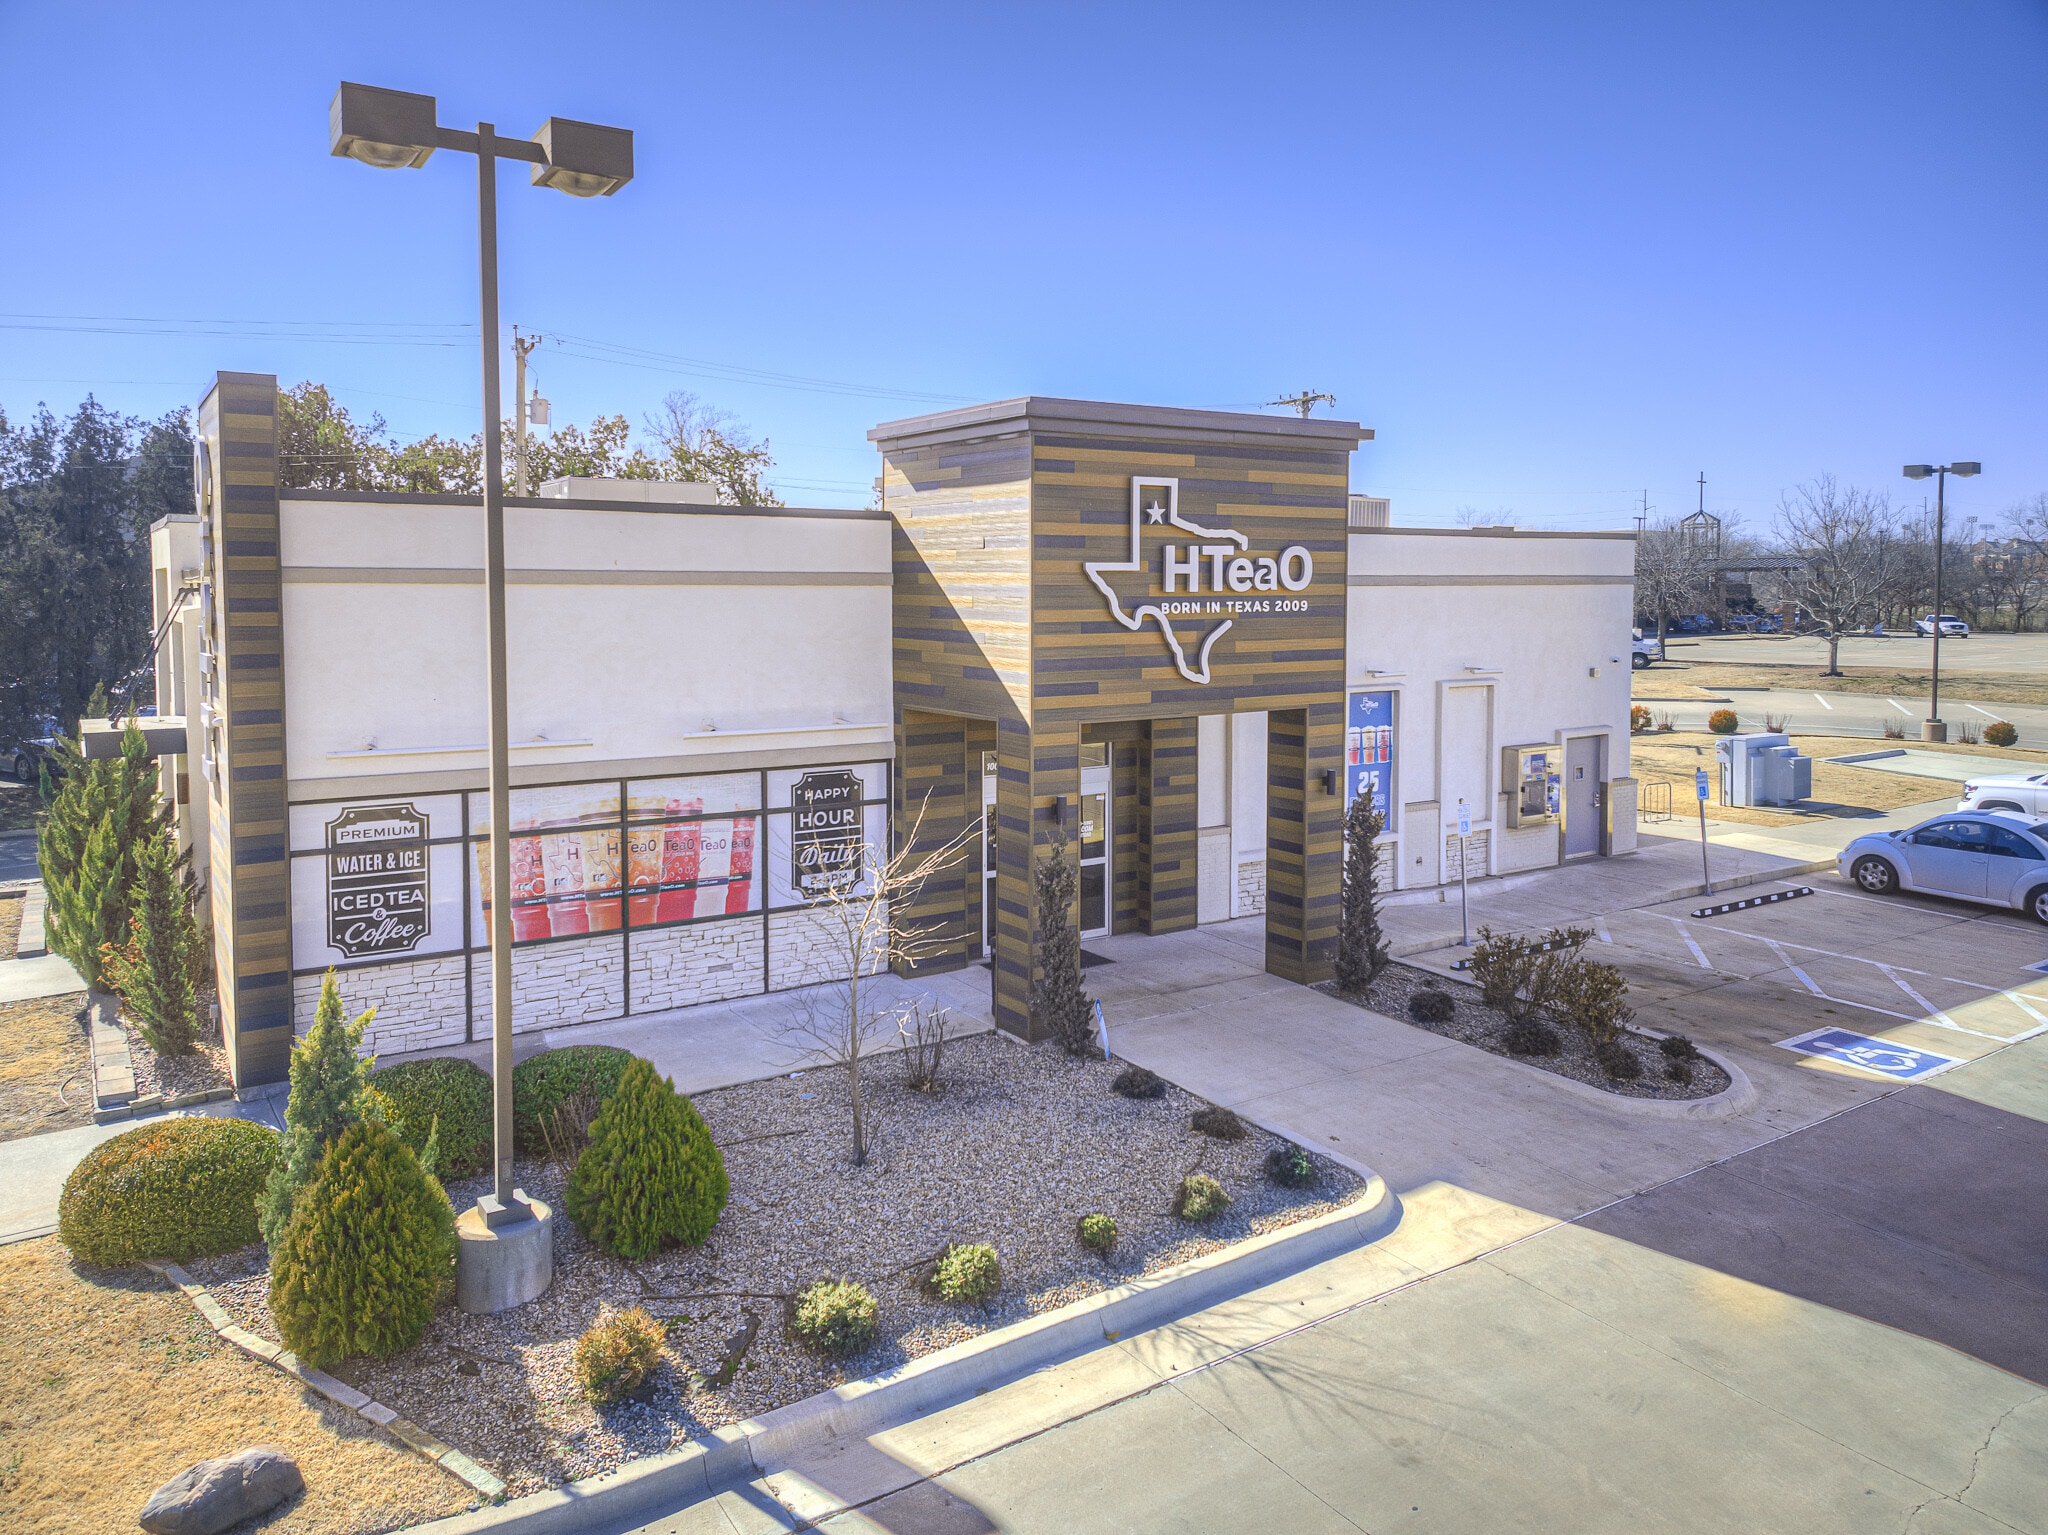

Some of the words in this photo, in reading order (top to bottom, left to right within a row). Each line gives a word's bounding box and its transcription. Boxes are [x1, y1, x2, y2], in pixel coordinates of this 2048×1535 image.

[1162, 545, 1313, 593] HTeaO
[1161, 602, 1200, 615] BORN
[1206, 602, 1221, 614] IN
[1226, 601, 1270, 613] TEXAS
[1274, 600, 1308, 612] 2009
[1358, 770, 1380, 794] 25
[804, 787, 850, 801] HAPPY
[800, 809, 855, 828] HOUR
[340, 825, 416, 841] PREMIUM
[607, 839, 657, 856] HeaO
[800, 843, 857, 867] Daily
[336, 853, 383, 874] WATER
[385, 852, 396, 869] &
[399, 850, 421, 868] ICE
[375, 909, 384, 919] &
[344, 917, 416, 947] Coffee
